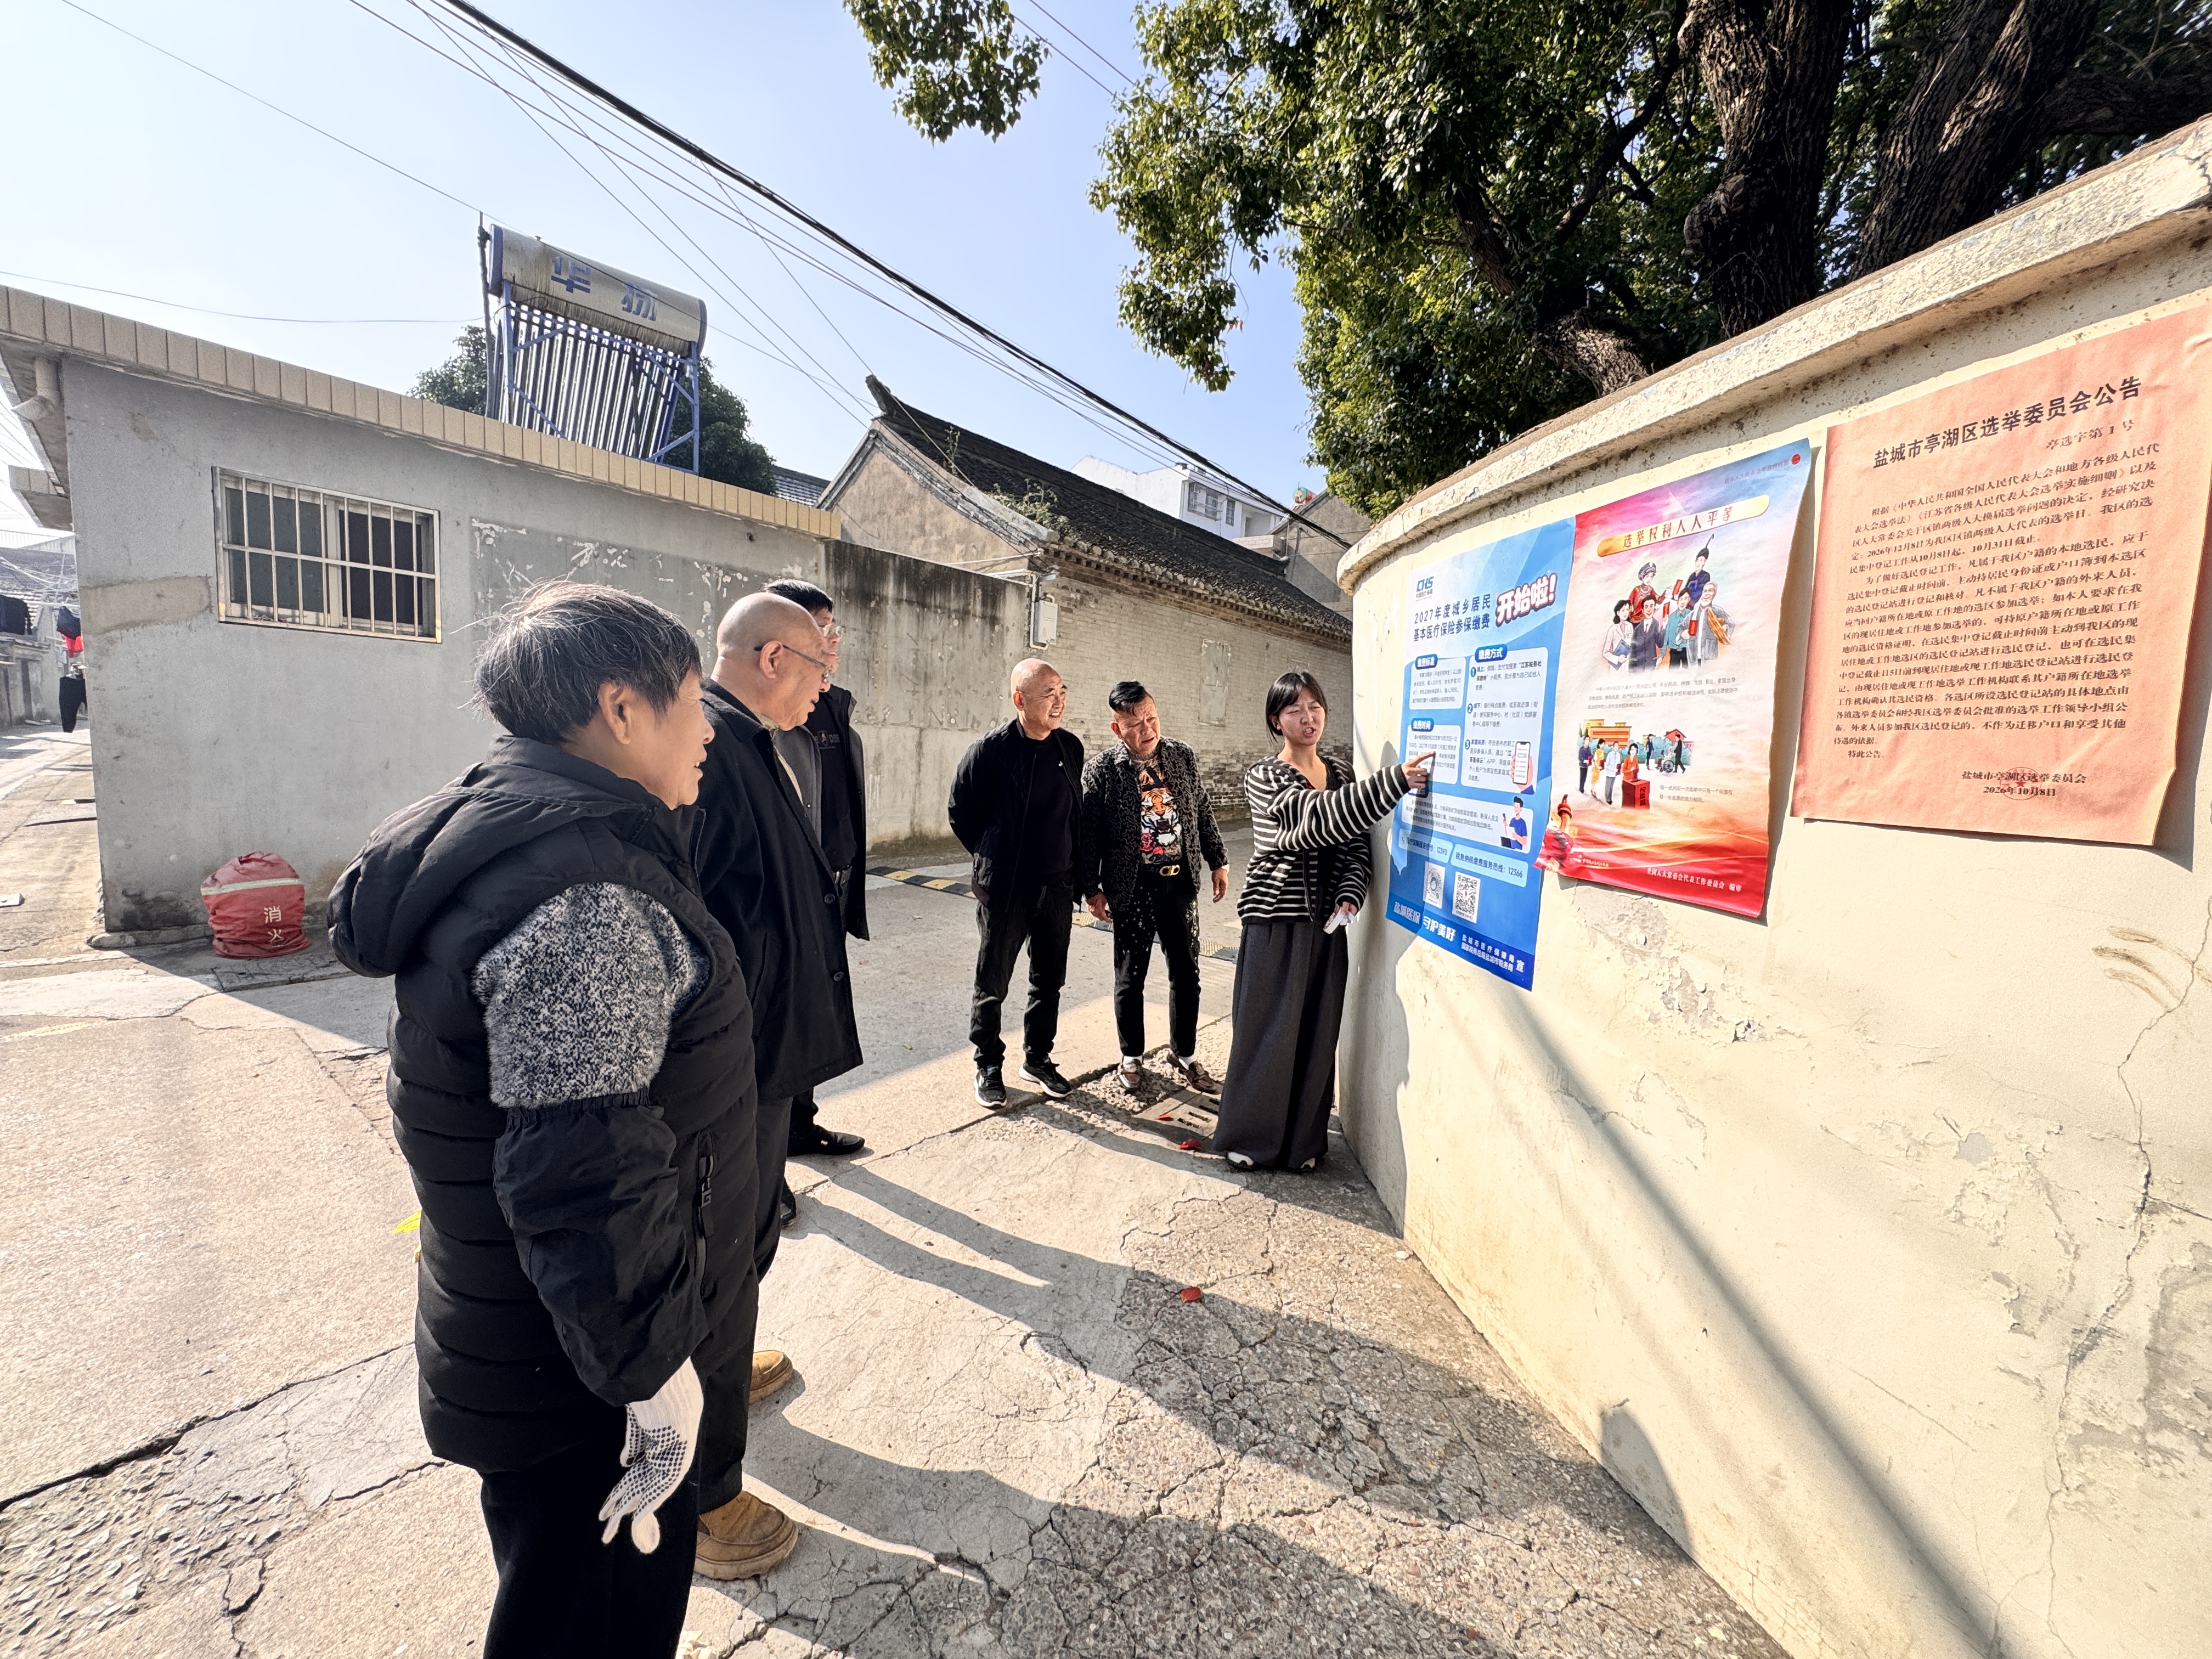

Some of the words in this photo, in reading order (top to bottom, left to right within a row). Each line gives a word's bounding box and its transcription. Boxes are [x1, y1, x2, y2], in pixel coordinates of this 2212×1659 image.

[1872, 376, 2142, 469] 盐城市亭湖区选举委员会公告
[1623, 506, 1734, 548] 选举权利人人平等
[1414, 594, 1491, 624] 2027年度城乡居民
[1413, 613, 1490, 642] 基本医疗保险参保缴费
[1983, 786, 2056, 797] 2026年10月8日
[1647, 867, 1725, 889] 全国人大常委会代表工作委员会
[263, 905, 284, 948] 消火
[1423, 915, 1456, 942] 守护美好
